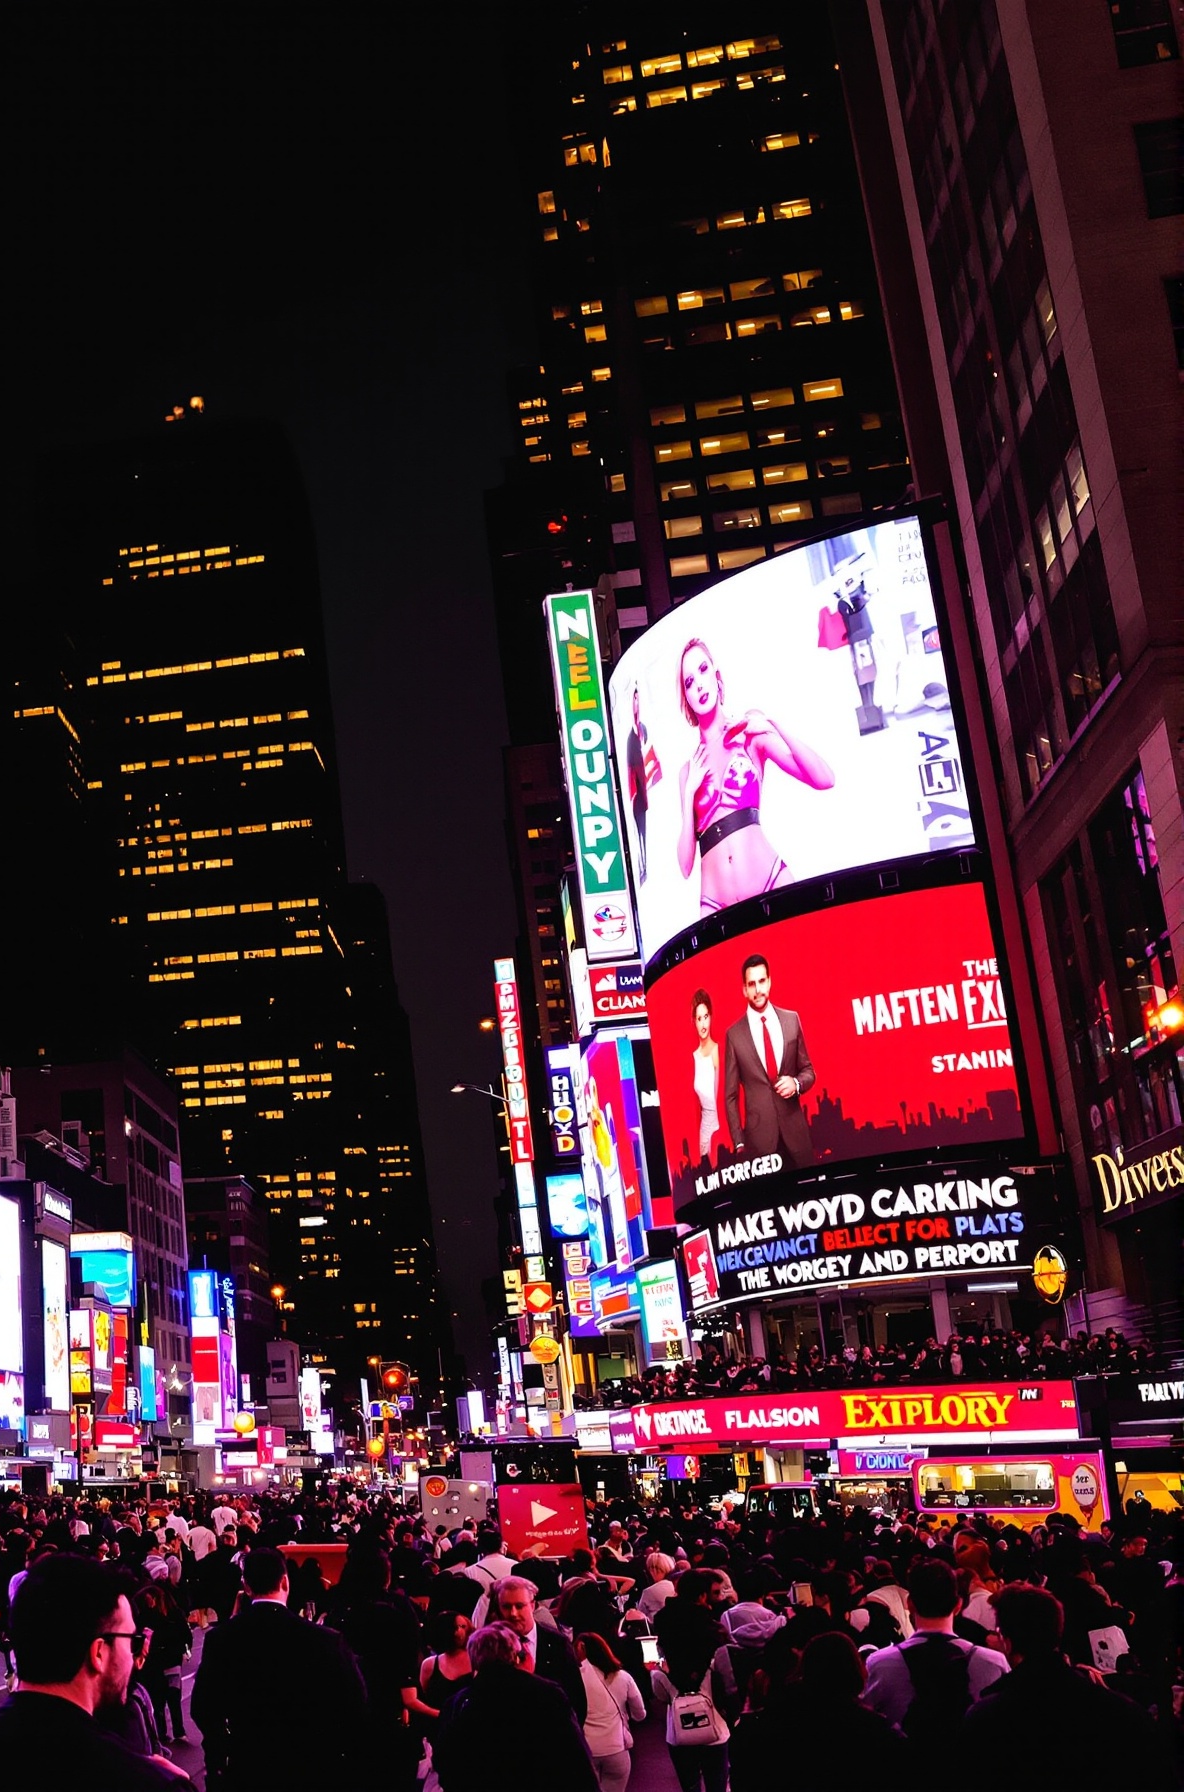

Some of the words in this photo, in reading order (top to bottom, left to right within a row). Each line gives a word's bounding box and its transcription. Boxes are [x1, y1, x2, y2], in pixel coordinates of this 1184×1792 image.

[718, 1208, 778, 1250] MAKE
[778, 1193, 865, 1235] WOYD
[871, 1176, 1019, 1219] CARKING
[905, 1217, 951, 1242] FOR
[954, 1212, 1025, 1237] PLATS
[737, 1265, 772, 1292] THE
[859, 1249, 909, 1275] AND
[914, 1239, 1020, 1270] PERPORT
[841, 1392, 1015, 1428] EXIPLORY
